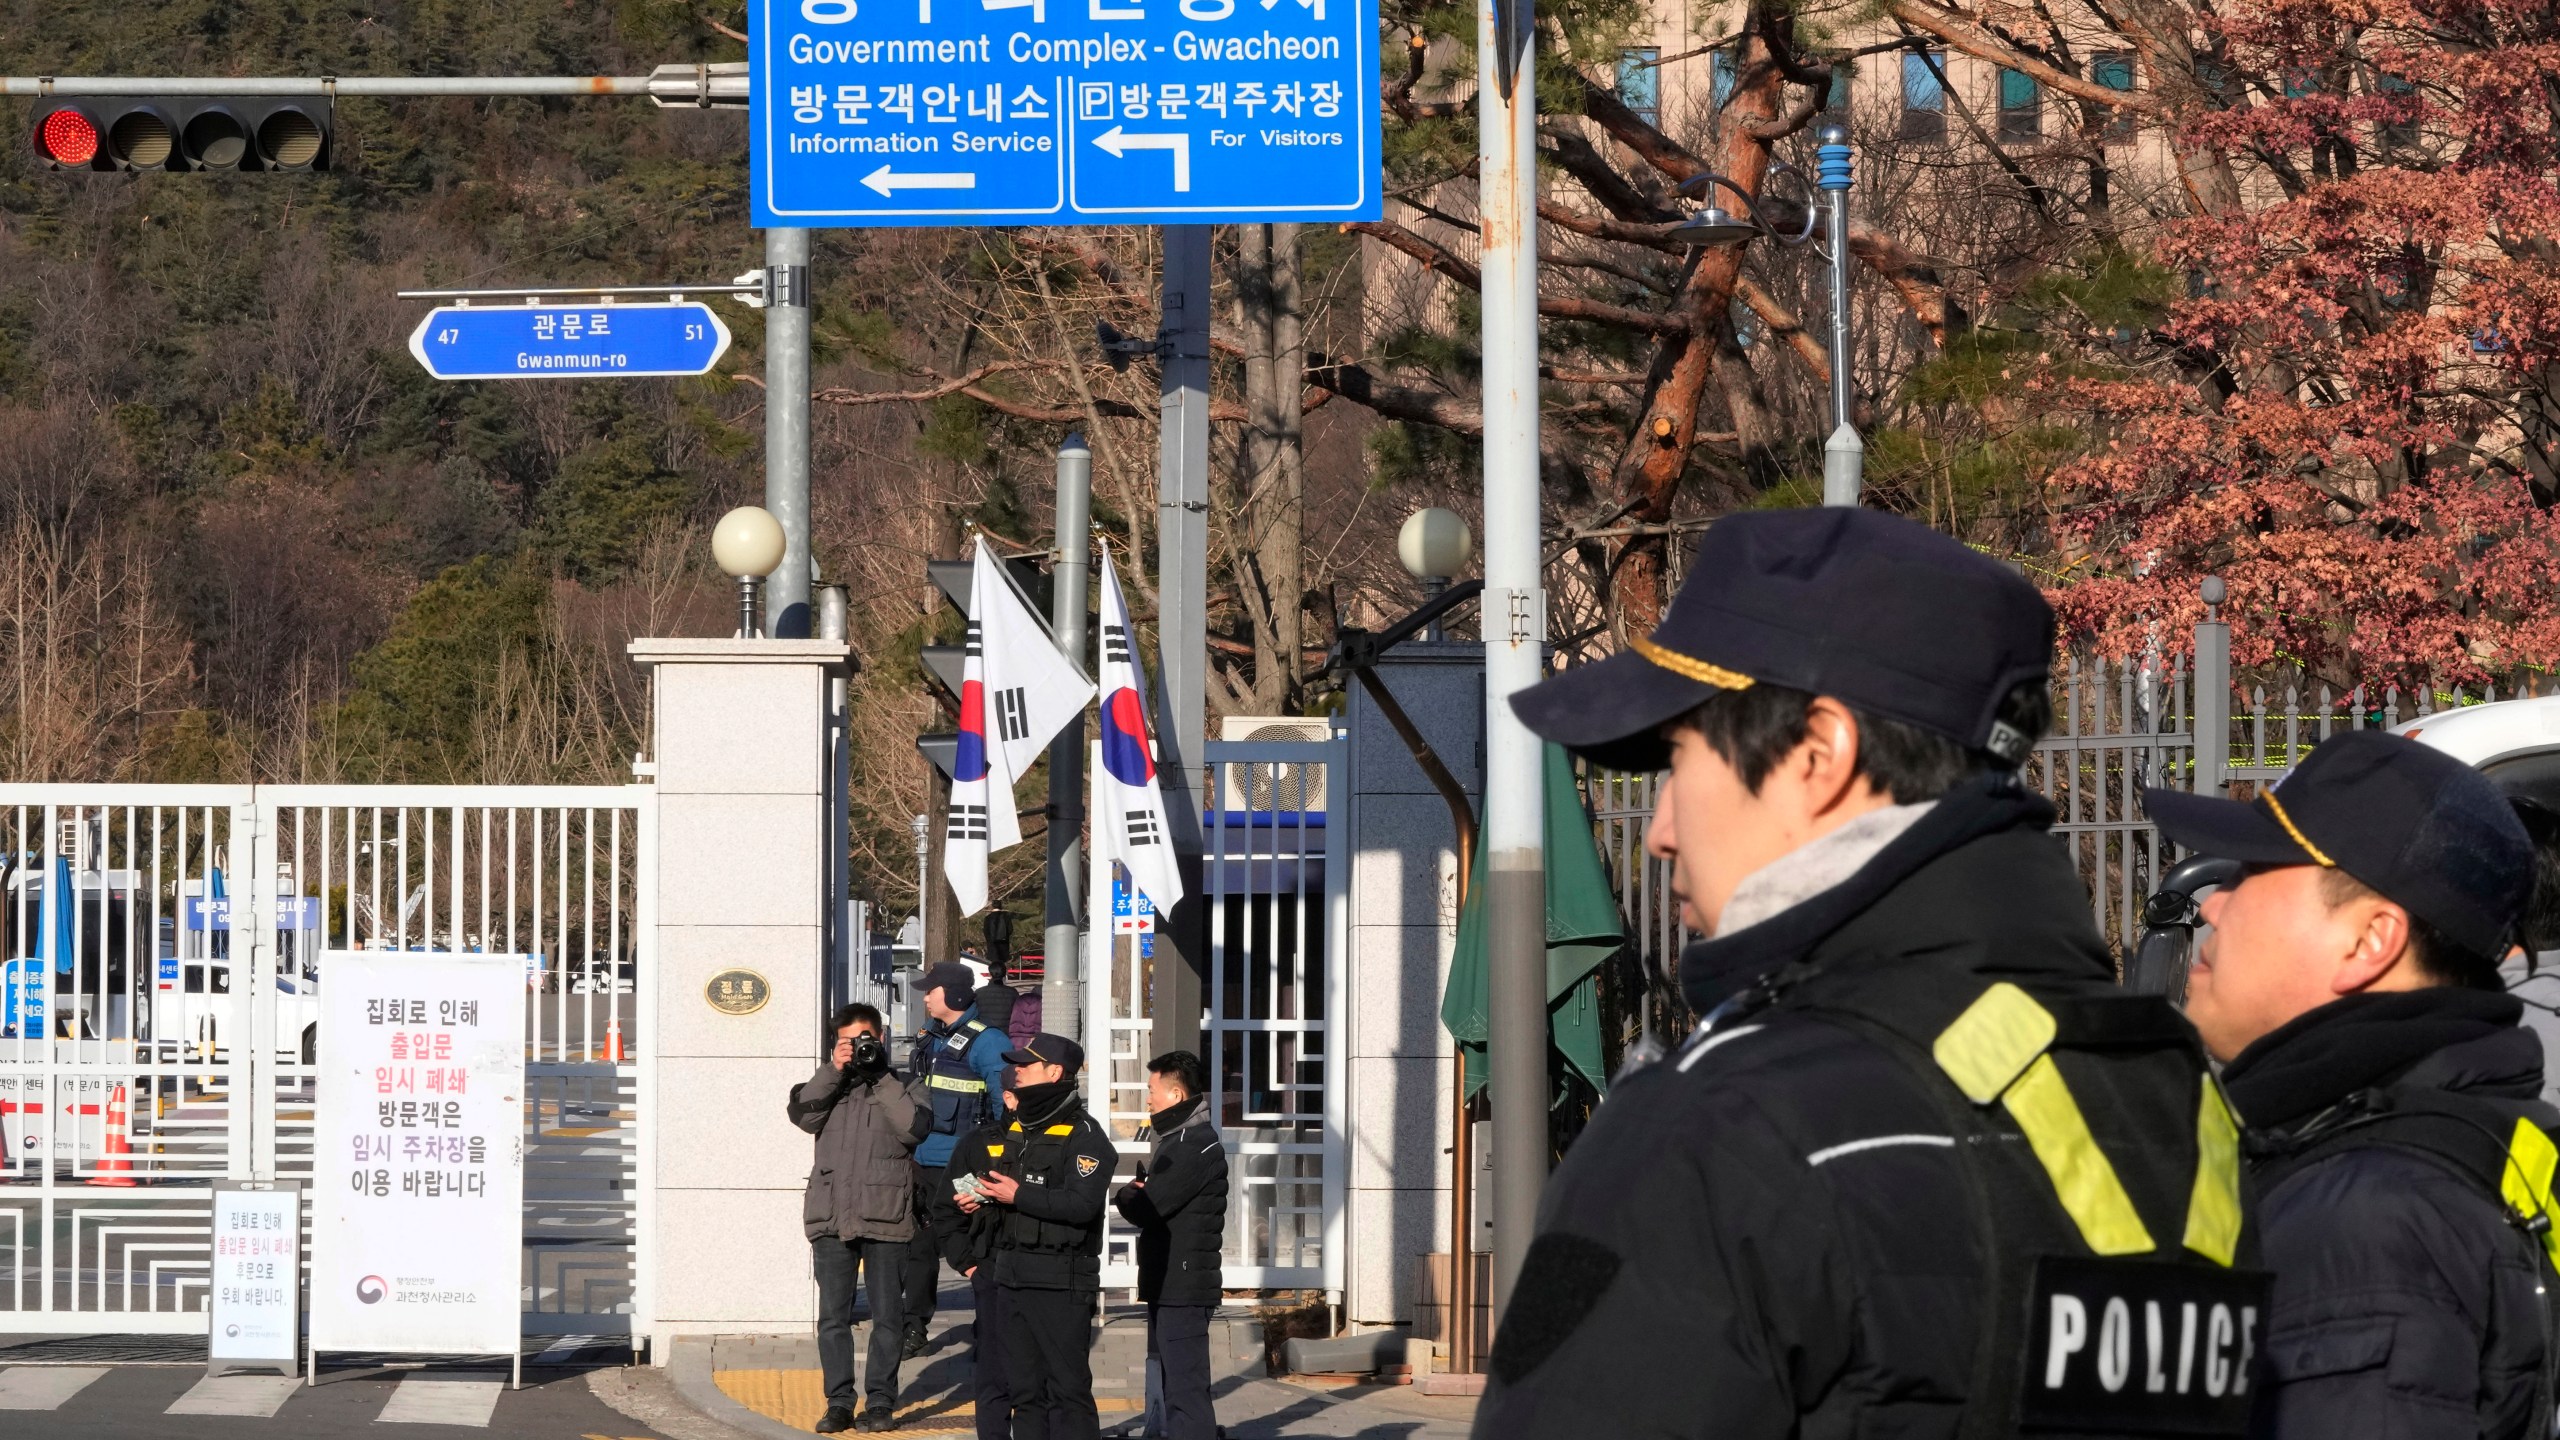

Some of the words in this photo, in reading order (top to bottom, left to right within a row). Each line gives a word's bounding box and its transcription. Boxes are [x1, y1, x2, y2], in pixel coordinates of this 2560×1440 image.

[789, 33, 990, 64] Government
[790, 83, 1050, 124] 방문객안내소
[1120, 81, 1343, 120] 방문객주차장
[790, 132, 939, 154] Information
[952, 130, 1052, 153] Service
[1211, 130, 1247, 147] For
[1260, 129, 1343, 146] Visitors
[438, 329, 459, 345] 47
[532, 313, 611, 340] 관문로
[685, 324, 703, 341] 51
[517, 351, 627, 369] Gwanmun-ro
[366, 998, 428, 1026] 집회로
[440, 999, 479, 1027] 인해
[391, 1032, 453, 1060] 출입문
[376, 1067, 415, 1094] 임시
[426, 1067, 468, 1095] 폐쇄
[941, 1079, 977, 1092] POLICE
[378, 1101, 462, 1129] 방문객은
[352, 1134, 392, 1162] 임시
[403, 1135, 487, 1164] 주차장을
[351, 1168, 392, 1197] 이용
[403, 1169, 486, 1198] 바랍니다
[231, 1212, 259, 1230] 집회로
[264, 1212, 282, 1230] 인해
[218, 1236, 247, 1256] 출입문
[251, 1237, 270, 1256] 임시
[274, 1238, 293, 1256] 폐쇄
[236, 1262, 274, 1280] 후문으로
[221, 1287, 240, 1306] 우회
[395, 1291, 477, 1304] 과천청사관리소
[2045, 1294, 2256, 1397] POLICE
